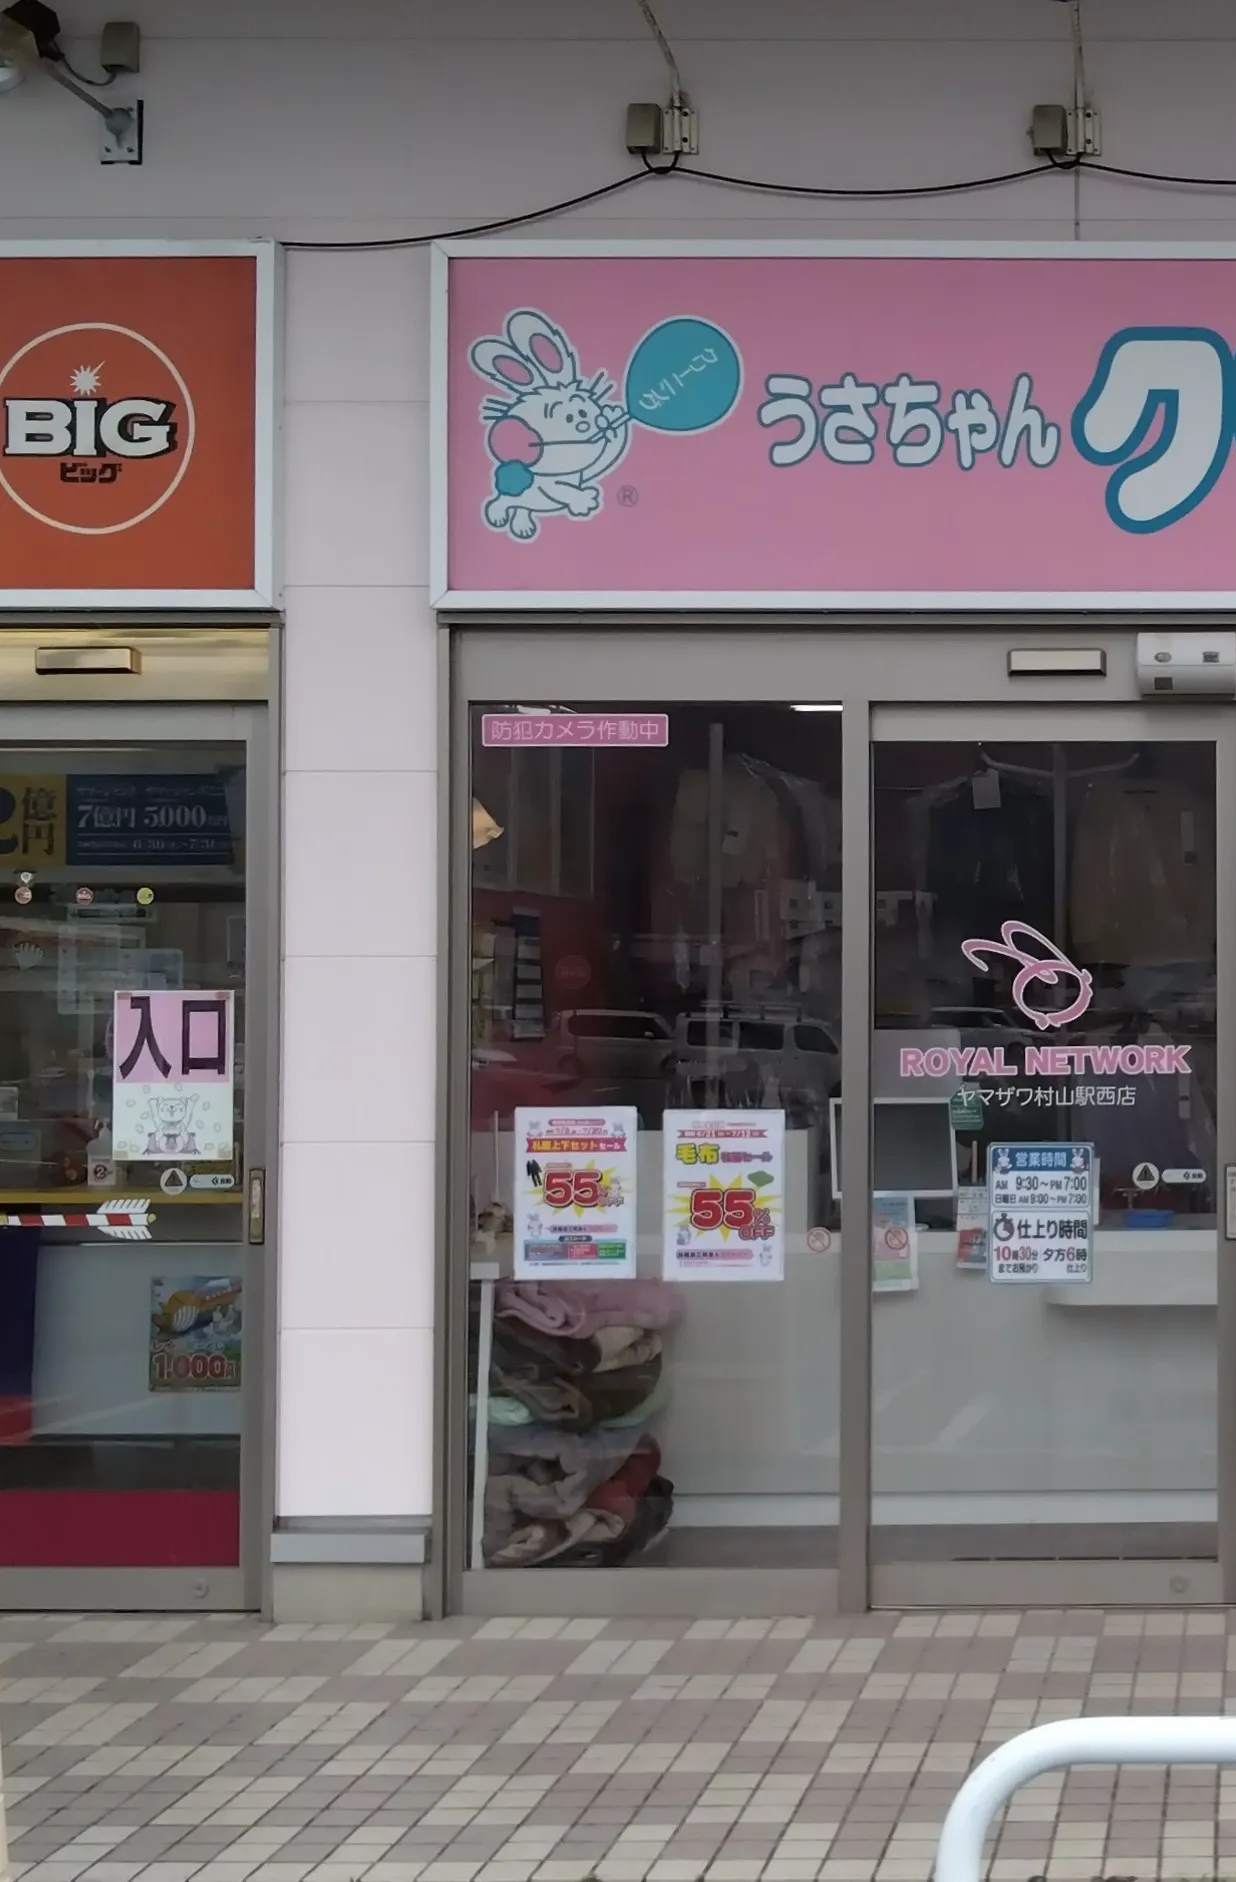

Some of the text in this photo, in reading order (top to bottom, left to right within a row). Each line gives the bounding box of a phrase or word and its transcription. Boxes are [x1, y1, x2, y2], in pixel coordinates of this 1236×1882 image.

[5, 397, 178, 458] BIG
[757, 373, 1060, 470] うさちゃん
[60, 462, 123, 483] ビッグ
[491, 719, 660, 741] 防犯カメラ作動中
[119, 996, 226, 1080] 入口
[900, 1045, 1192, 1077] ROYAL NETWORK
[957, 1086, 1137, 1107] ヤマザワ村山駅西店
[676, 1143, 720, 1165] 毛布
[1015, 1152, 1067, 1167] 営業時間
[544, 1170, 602, 1208] 55
[739, 1225, 775, 1241] OFF
[1017, 1220, 1088, 1240] 仕上り時間
